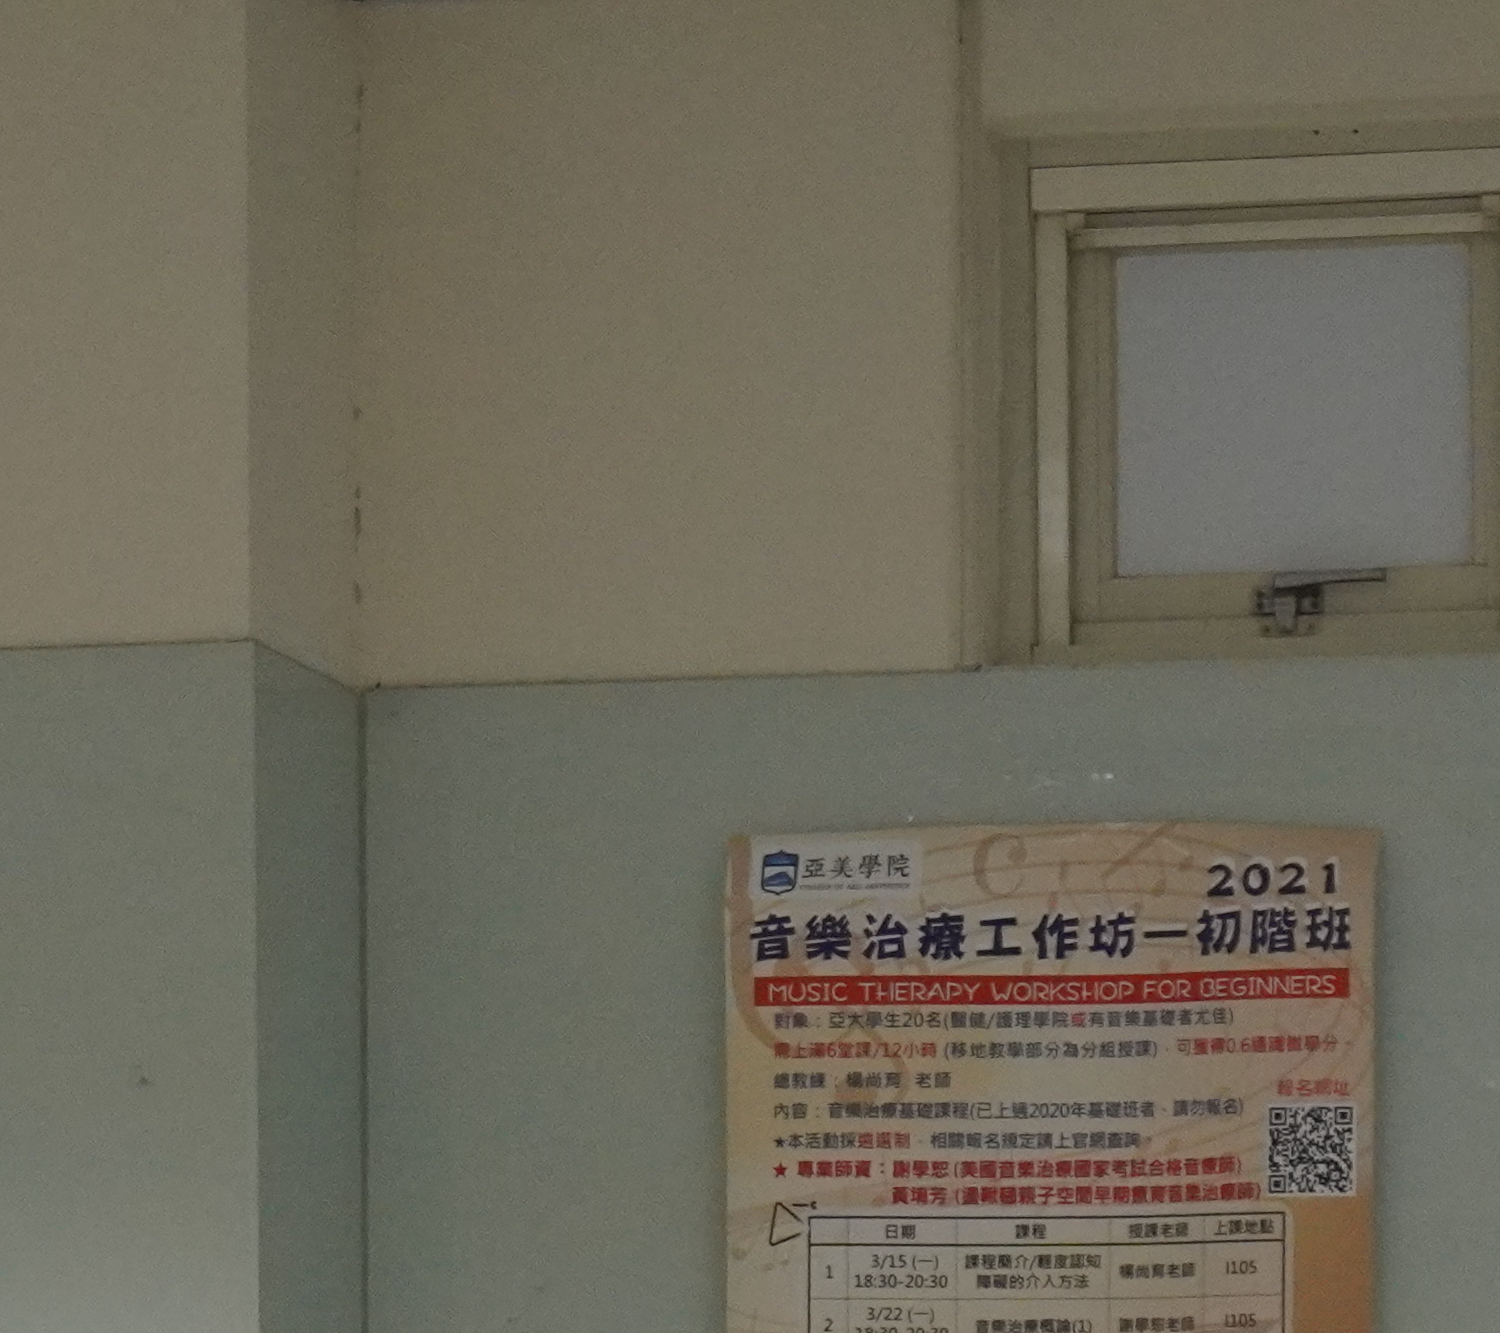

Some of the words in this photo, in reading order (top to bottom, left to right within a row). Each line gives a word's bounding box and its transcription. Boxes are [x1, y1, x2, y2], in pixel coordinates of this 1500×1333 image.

[802, 854, 911, 880] 亞美學院
[1207, 862, 1337, 897] 2021
[768, 982, 848, 1002] MUSIC
[858, 981, 981, 1002] THERAPY
[990, 980, 1135, 1002] WORKSHOP
[1143, 979, 1192, 999] FOR
[1201, 974, 1337, 998] BEGINNERS
[915, 1071, 952, 1089] 老師
[1277, 1078, 1350, 1097] 報名網址
[885, 1224, 916, 1240] 日期
[1015, 1223, 1047, 1240] 課程
[1128, 1221, 1189, 1239] 授課老師
[1213, 1219, 1275, 1237] 上課地點
[825, 1265, 834, 1279] 1
[871, 1254, 907, 1270] 3/15
[912, 1254, 940, 1271] (一)
[854, 1274, 948, 1289] 18:30-20:30
[824, 1318, 834, 1332] 2
[866, 1307, 903, 1322] 3/22
[908, 1307, 935, 1323] (一)
